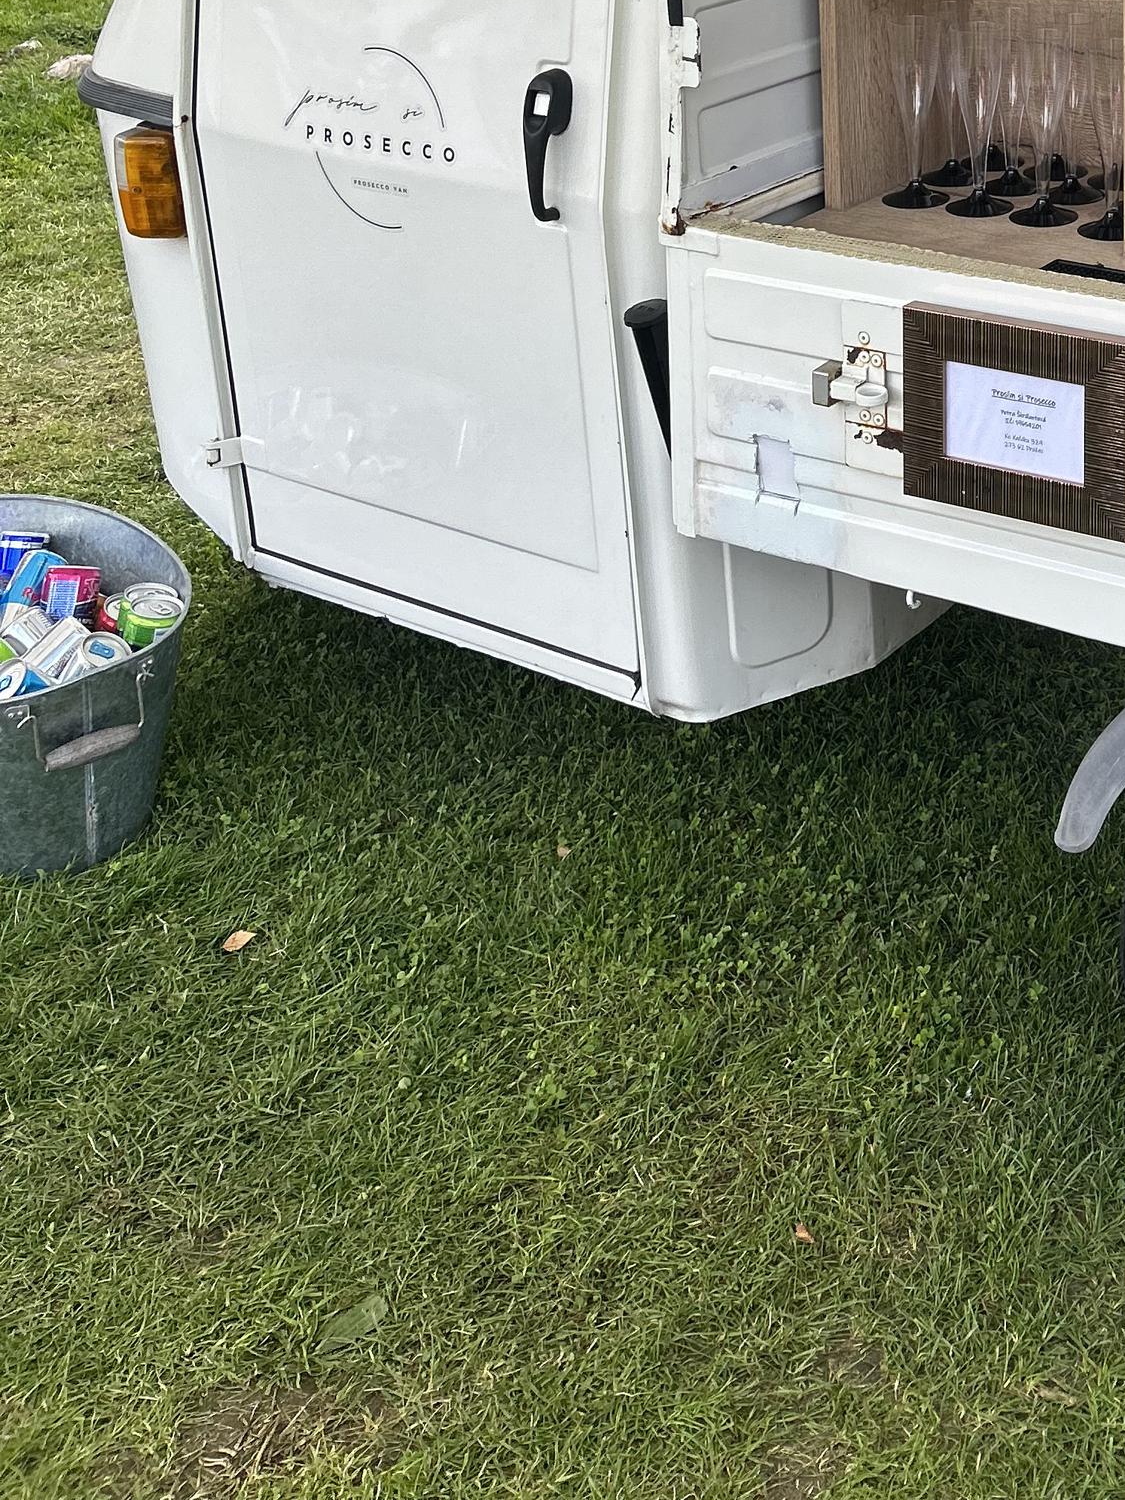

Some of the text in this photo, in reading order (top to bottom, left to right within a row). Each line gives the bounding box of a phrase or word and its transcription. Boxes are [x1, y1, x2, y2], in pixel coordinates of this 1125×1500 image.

[402, 107, 423, 120] si
[306, 124, 456, 163] PROSECCO
[353, 179, 390, 191] PROSECCO
